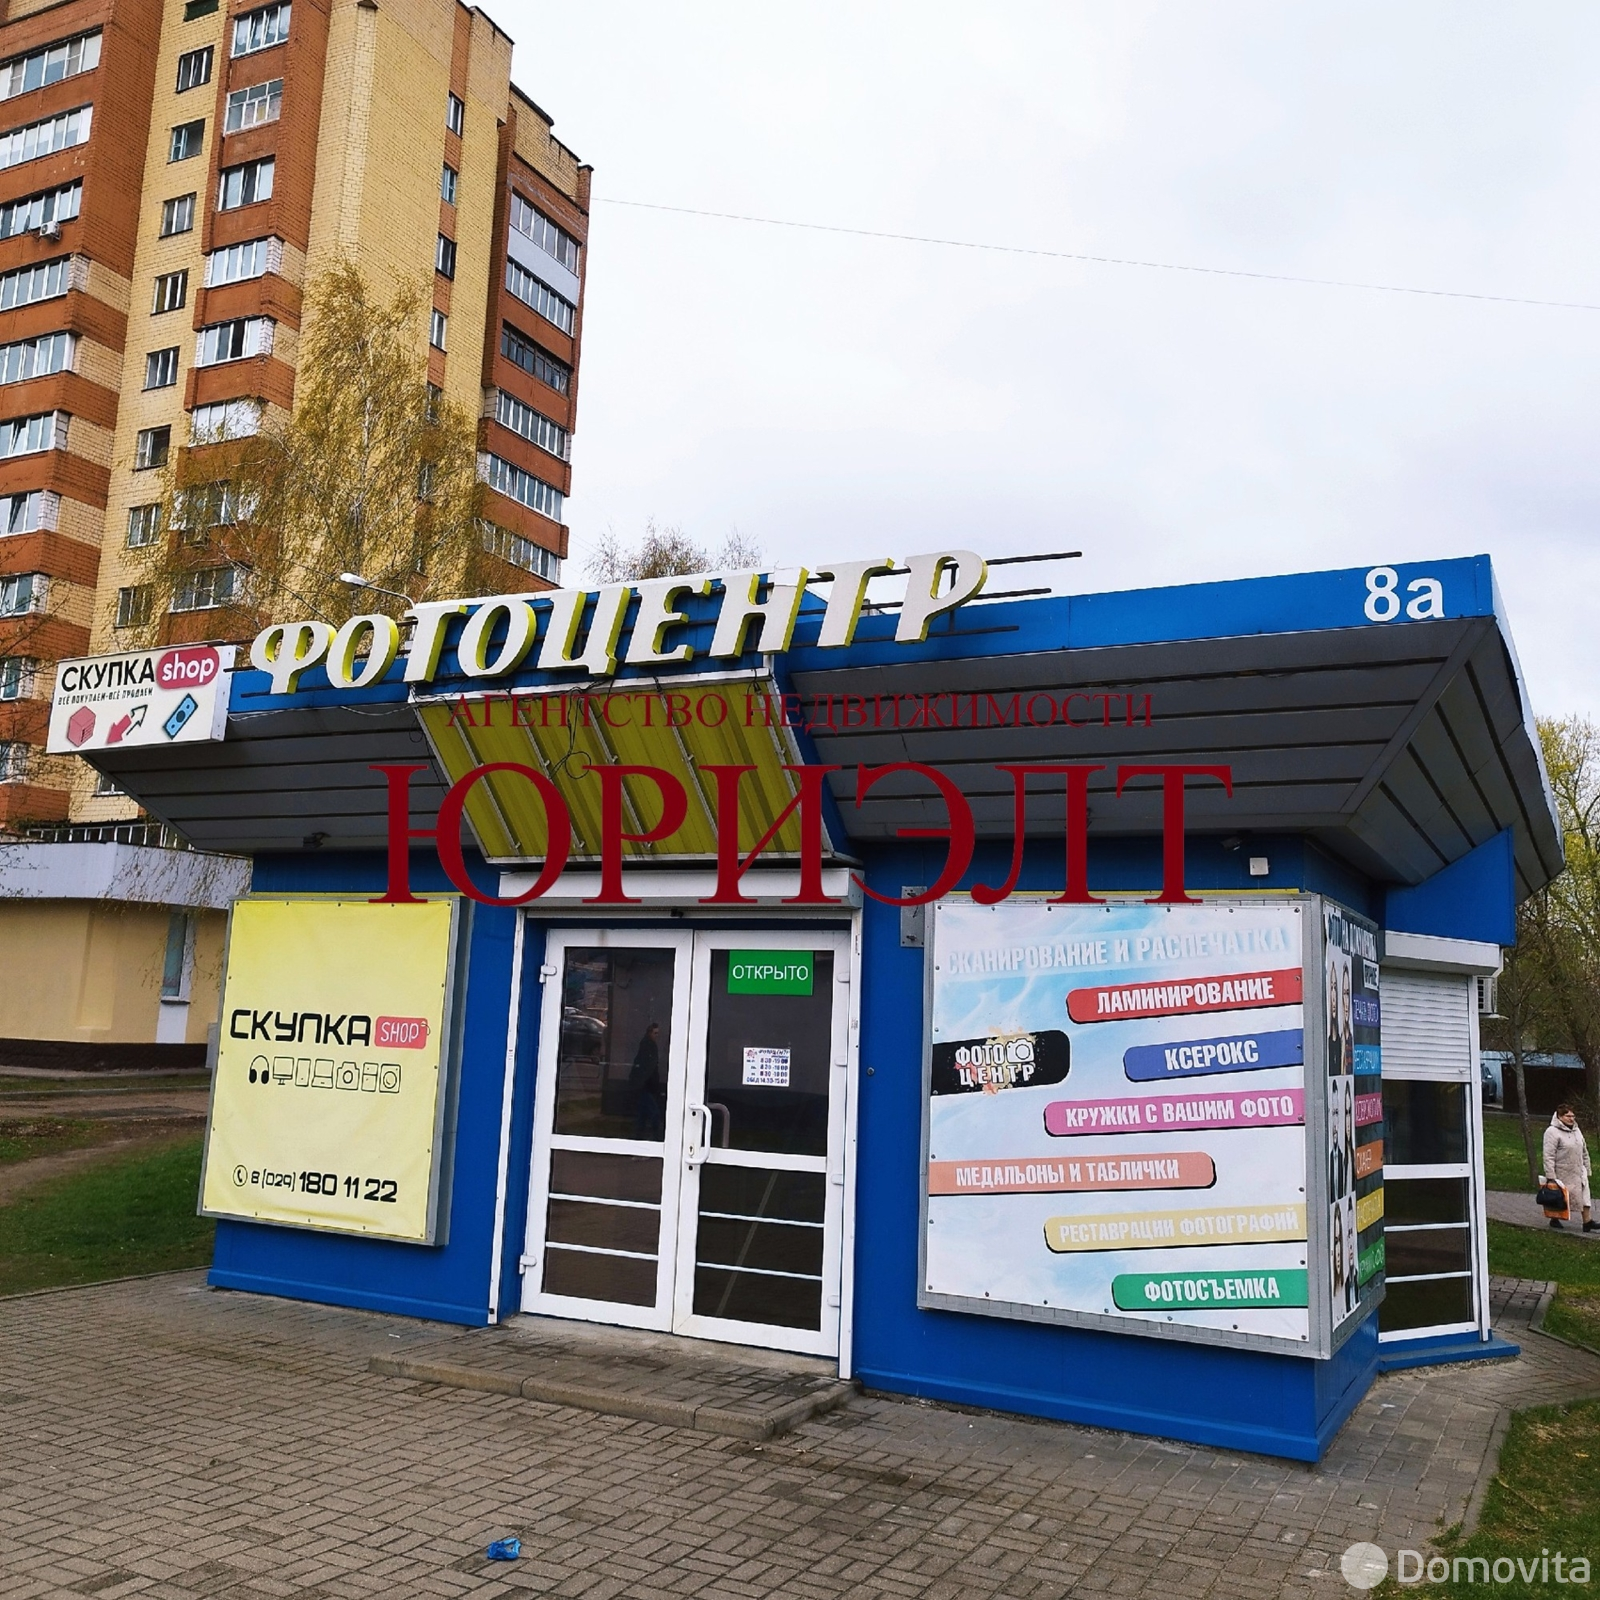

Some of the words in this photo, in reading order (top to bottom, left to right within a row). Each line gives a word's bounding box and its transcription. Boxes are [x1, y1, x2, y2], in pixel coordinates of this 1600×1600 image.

[250, 550, 988, 695] ФОТОЦЕНТР
[61, 657, 155, 692] СКУПКА
[161, 653, 215, 683] shop
[948, 940, 1106, 974] СКАНИРОВАНИЕ
[1114, 939, 1129, 963] И
[1138, 927, 1286, 961] РАСПЕЧАТКА
[732, 964, 809, 981] ОТКРЫТО
[1097, 977, 1275, 1014] ЛАМИНИРОВАНИЕ
[230, 1009, 371, 1046] СКУПКА
[380, 1020, 419, 1043] SHOP
[955, 1042, 1006, 1067] ФОТО
[1165, 1040, 1259, 1071] КСЕРОКС
[959, 1062, 1035, 1087] ЦЕНТР
[1066, 1104, 1141, 1128] КРУЖКИ
[1145, 1104, 1157, 1124] С
[1162, 1099, 1235, 1122] ВАШИМ
[1241, 1096, 1294, 1118] ФОТО
[250, 1170, 260, 1185] 8
[262, 1169, 296, 1192] (029)
[299, 1171, 337, 1196] 180
[344, 1176, 359, 1199] 11
[364, 1178, 398, 1203] 22
[956, 1163, 1065, 1189] МЕДАЛЬОНЫ
[1069, 1163, 1083, 1182] И
[1087, 1159, 1179, 1182] ТАБЛИЧКИ
[1060, 1217, 1175, 1243] РЕСТАВРАЦИИ
[1180, 1207, 1299, 1237] ФОТОГРАФИЙ
[1145, 1276, 1280, 1302] ФОТОСЪЕМКА
